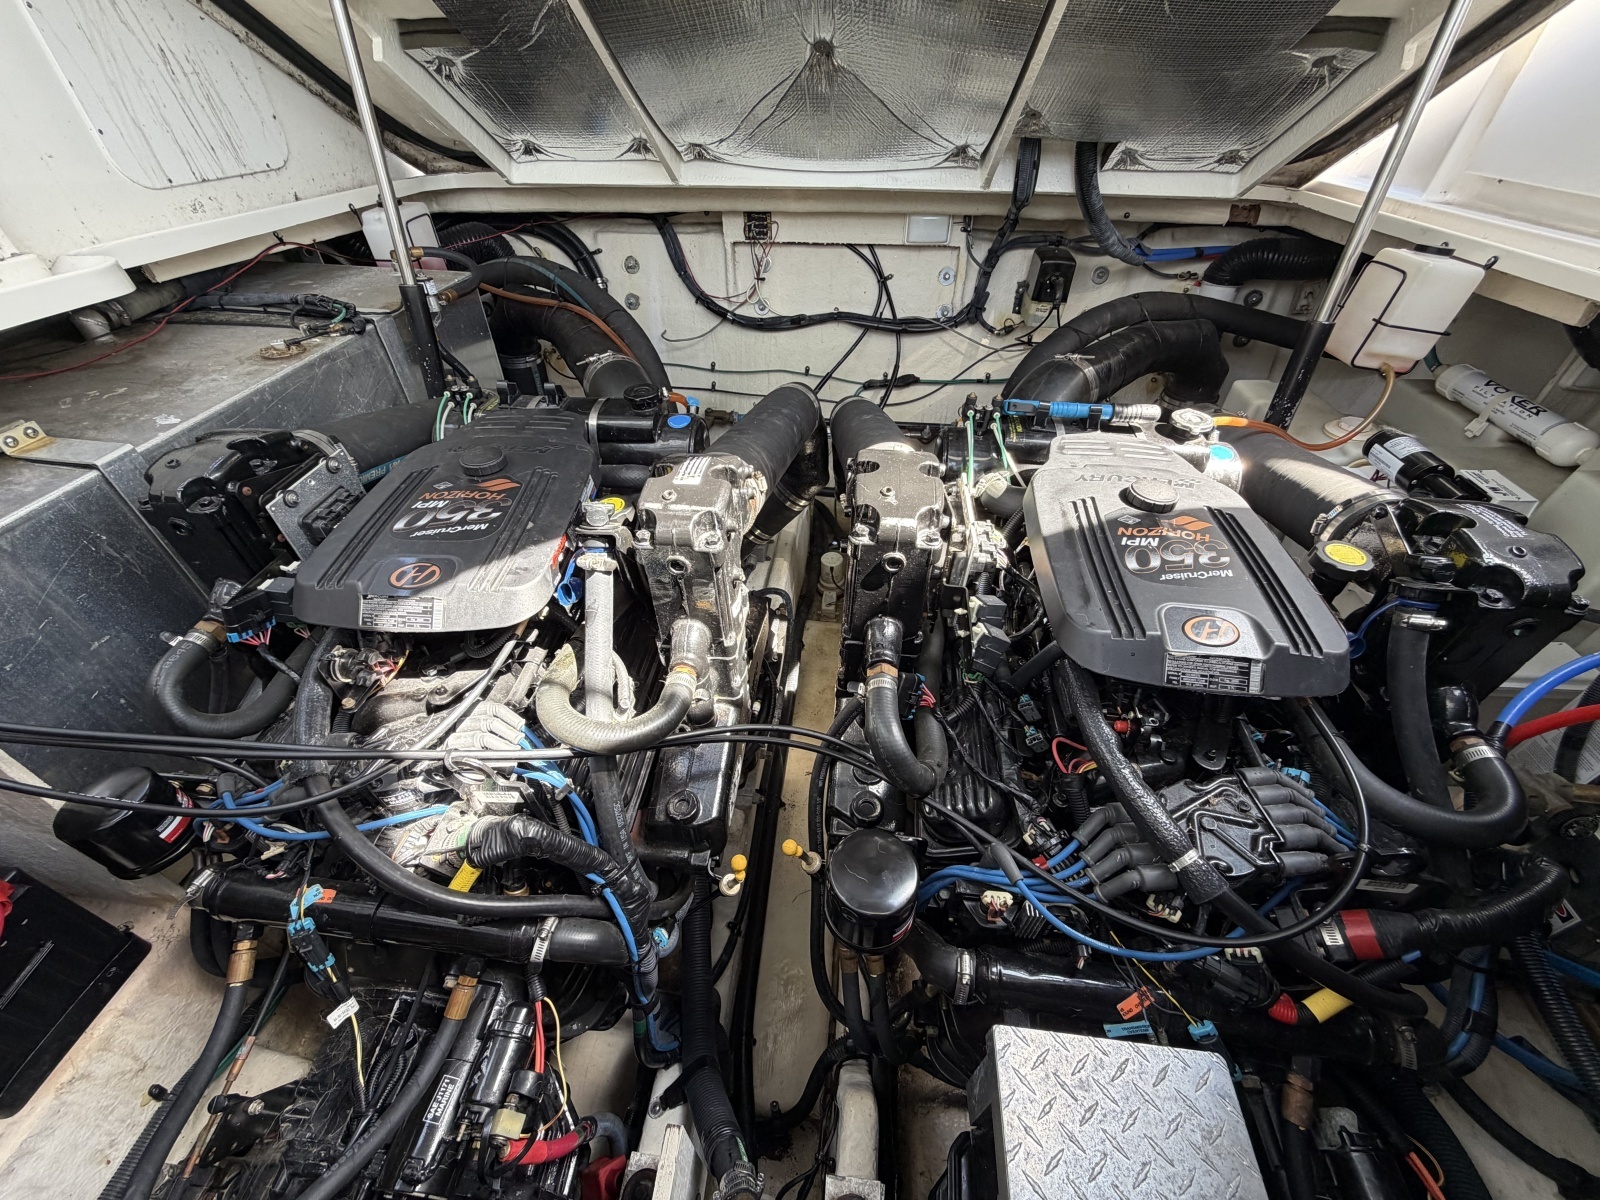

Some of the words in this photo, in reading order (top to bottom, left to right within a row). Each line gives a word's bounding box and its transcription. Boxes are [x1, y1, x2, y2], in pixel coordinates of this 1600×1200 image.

[1474, 385, 1533, 418] FILTATION
[419, 490, 507, 501] HORIZON
[411, 500, 450, 509] MPI
[392, 498, 513, 533] 350
[409, 523, 490, 538] MerCruiser
[1117, 526, 1211, 542] HORIZON
[1120, 537, 1160, 547] MPI
[1124, 539, 1231, 574] 350
[1159, 569, 1234, 581] MerCruiser
[426, 1101, 440, 1120] SAE
[436, 1078, 451, 1102] J1171
[434, 1083, 456, 1117] MARINE
